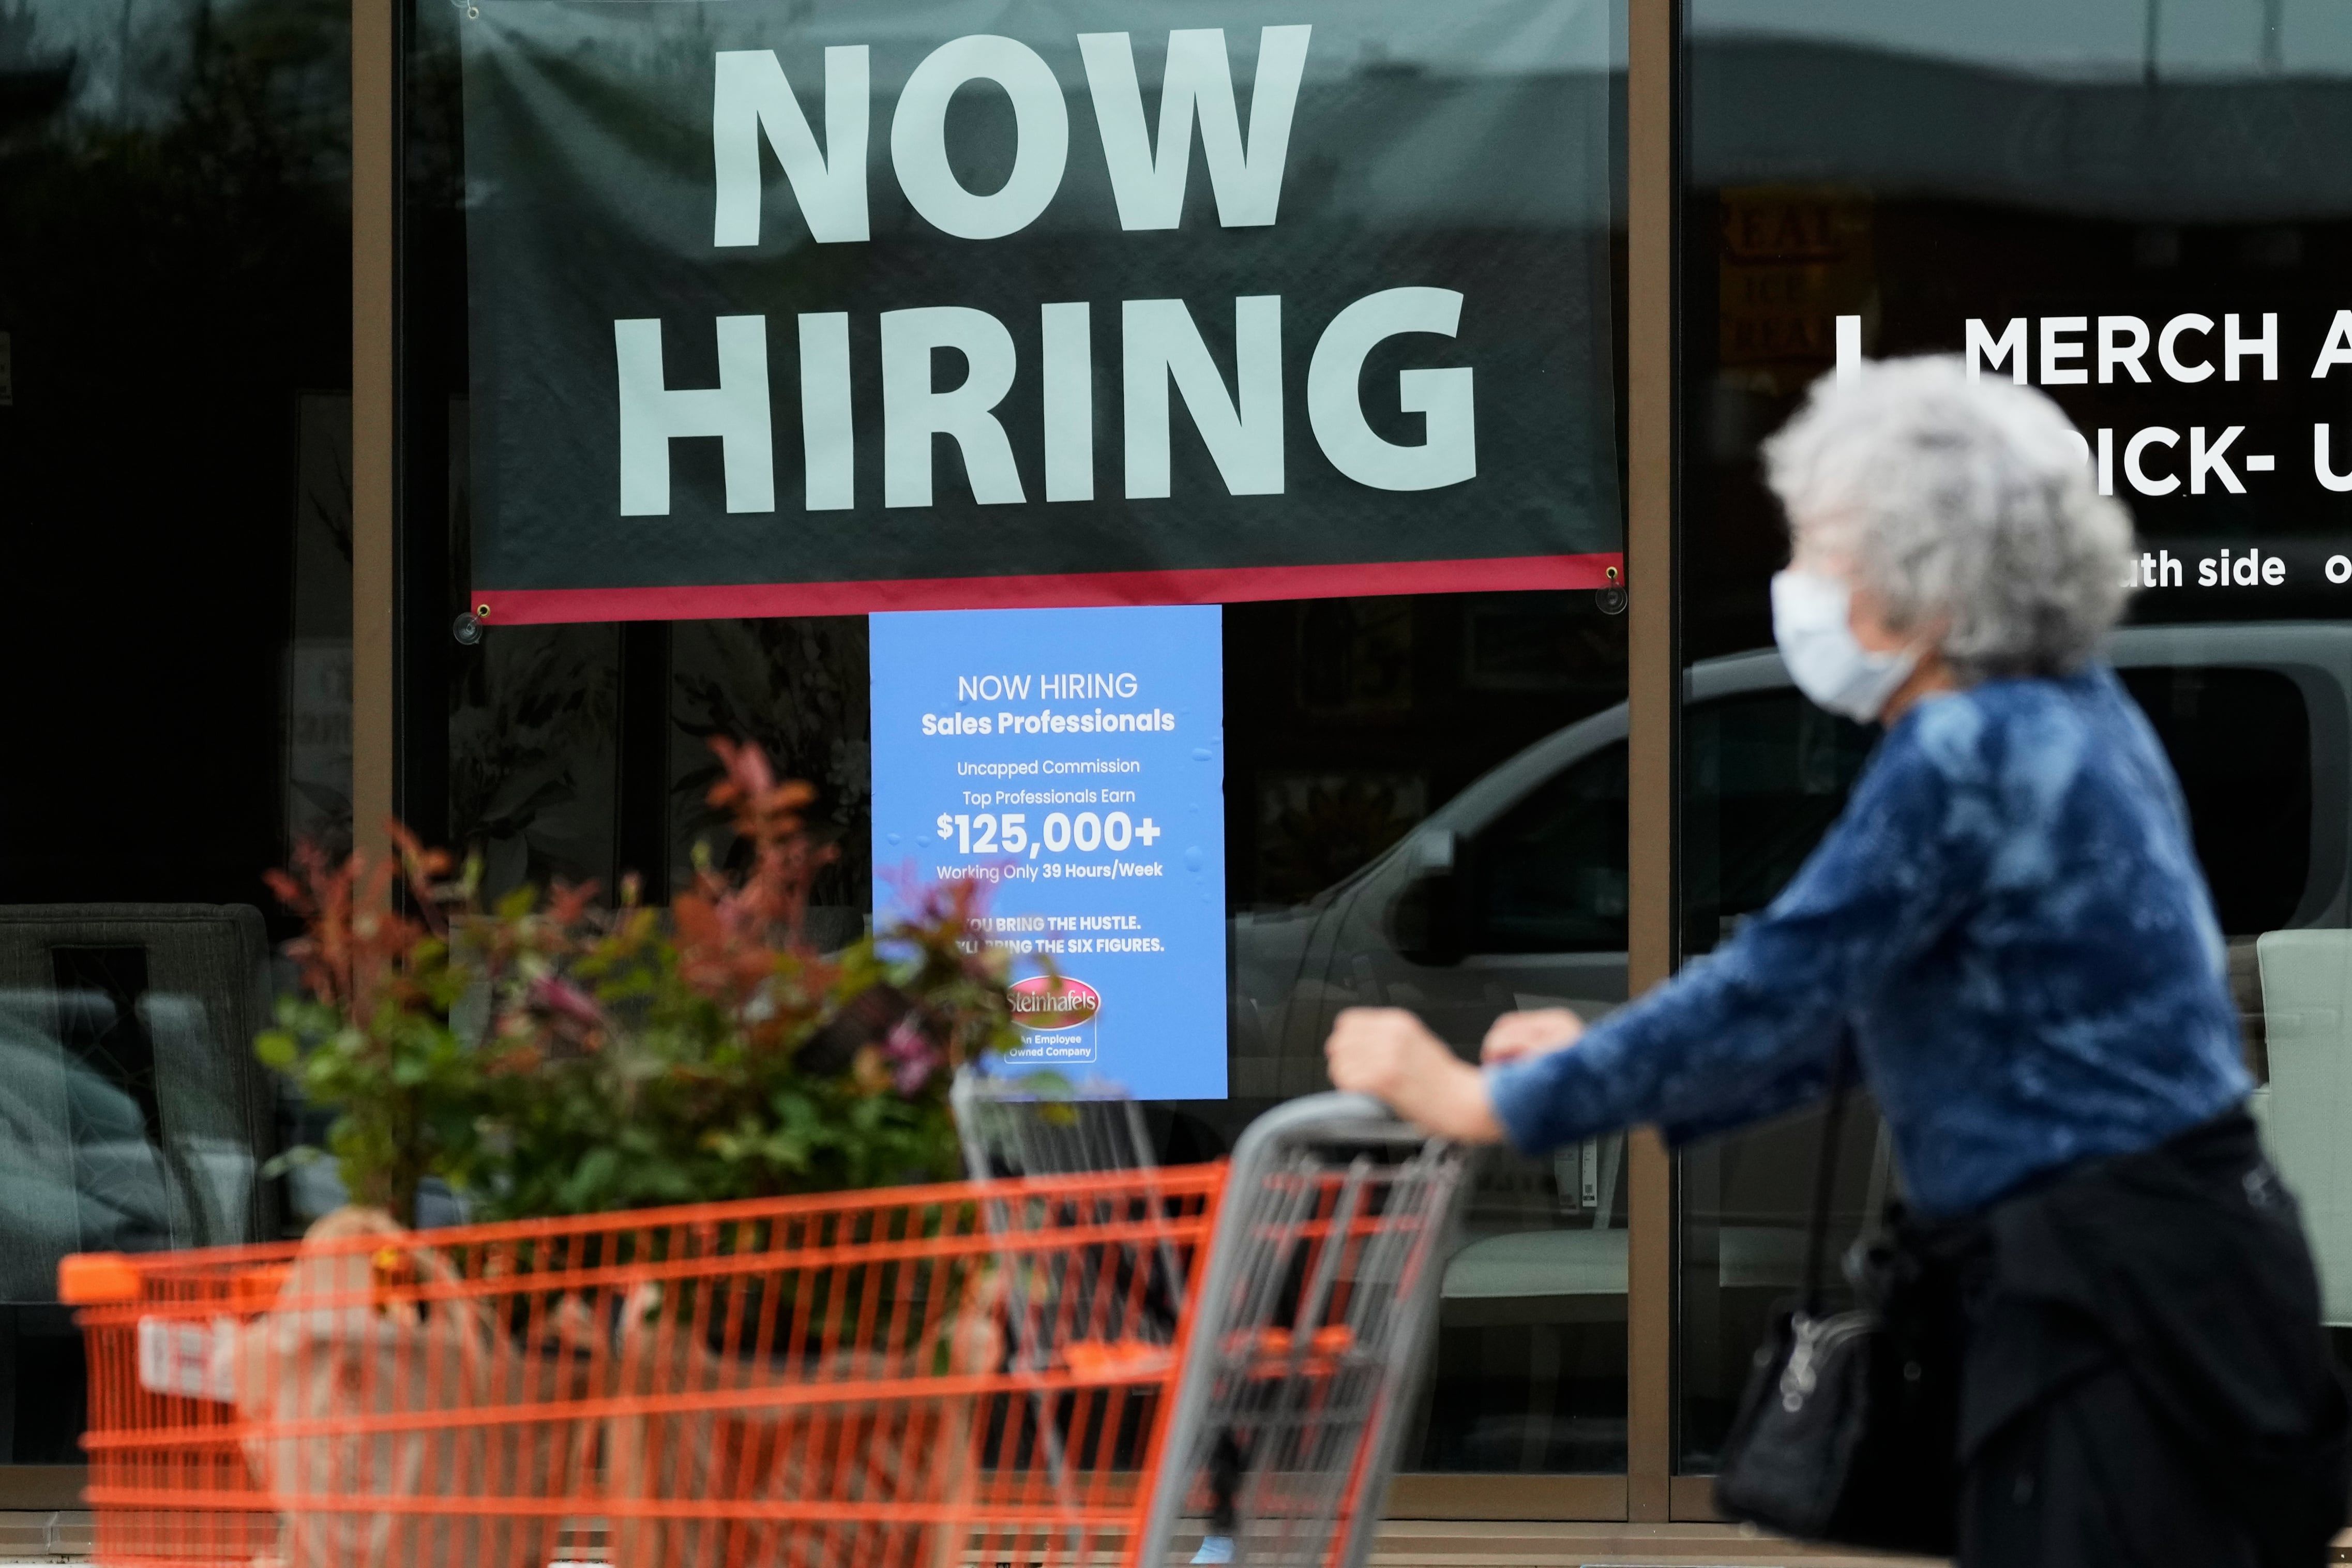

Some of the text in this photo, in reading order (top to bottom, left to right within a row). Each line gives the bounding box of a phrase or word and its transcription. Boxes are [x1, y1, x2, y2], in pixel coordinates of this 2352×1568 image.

[714, 24, 1313, 247] NOW
[1965, 313, 2278, 386] MERCH
[614, 286, 1477, 517] HIRING
[2197, 548, 2286, 586] side
[958, 672, 1138, 701] NOW HIRING
[922, 708, 1175, 735] Sales Professionals
[957, 759, 1140, 779] Uncapped Commission
[962, 789, 1136, 809] Top Professionals Earn
[937, 810, 1160, 860] $125,000+
[937, 859, 1163, 884] Working Only 39 Hours/Week
[966, 915, 1142, 932] OU BRING THE HUSTLE.
[1035, 940, 1065, 954] THE
[1068, 939, 1093, 954] SIX
[1096, 938, 1166, 953] FIGURES.
[1007, 990, 1095, 1013] Steinhafels
[1009, 1047, 1092, 1058] Owned Company
[1034, 1034, 1082, 1046] Employee
